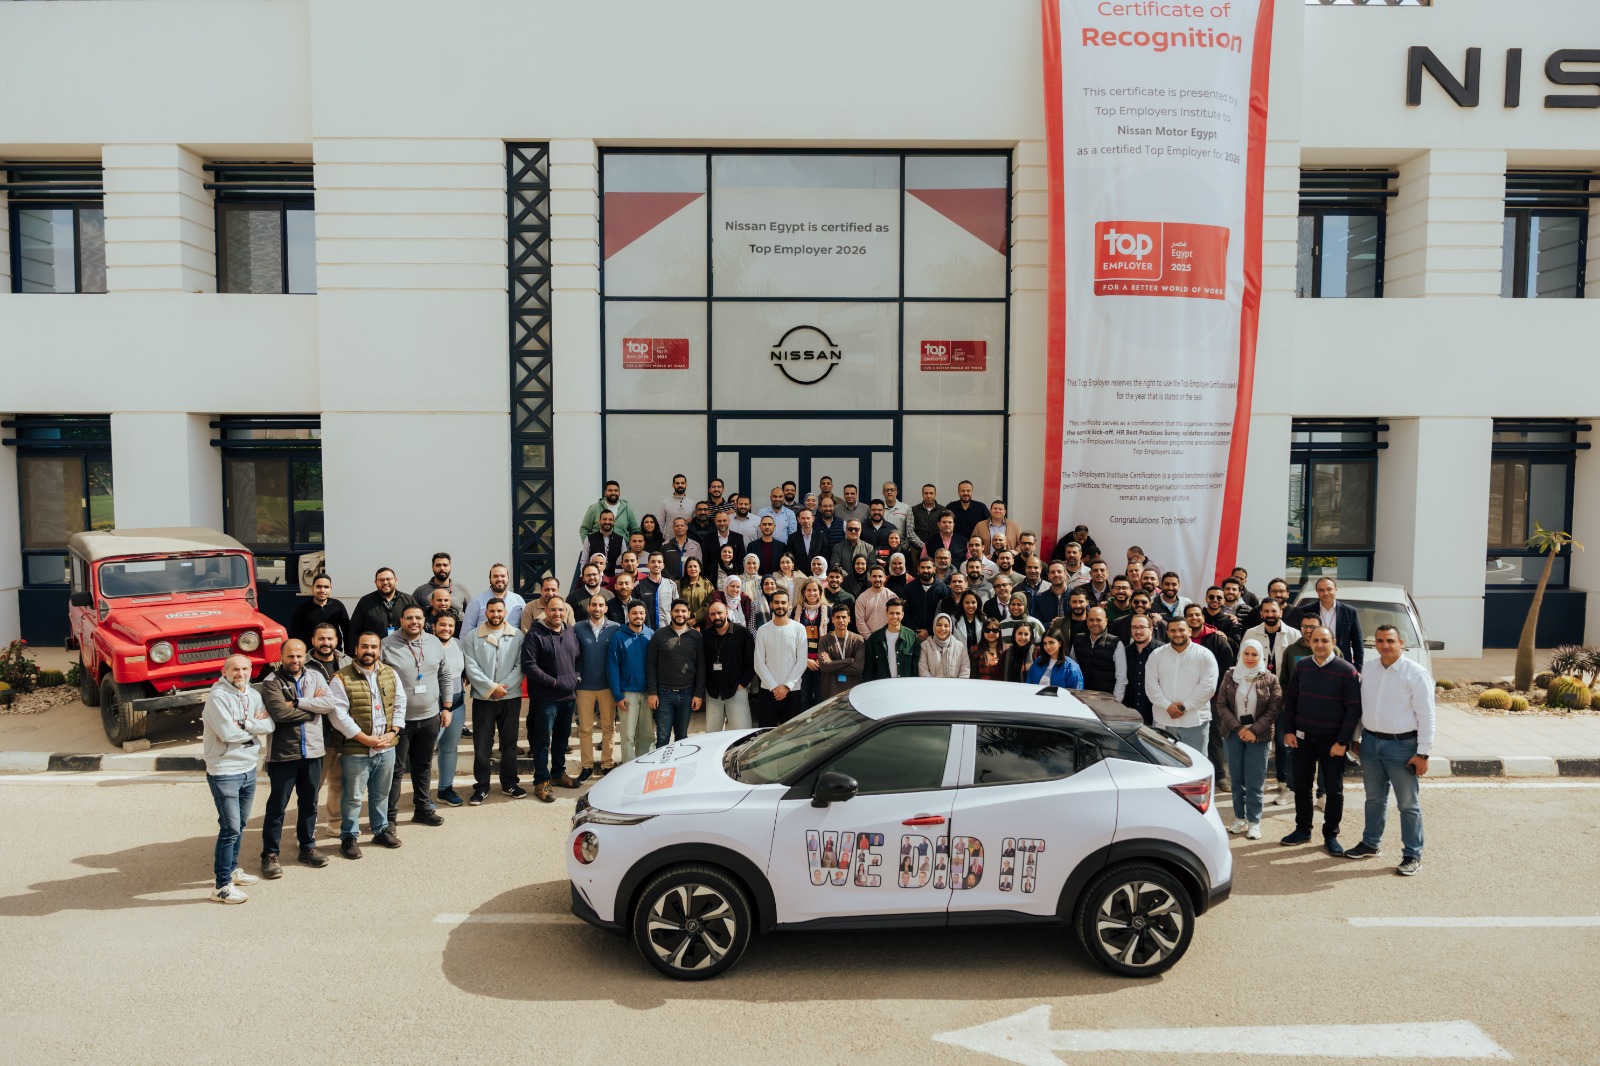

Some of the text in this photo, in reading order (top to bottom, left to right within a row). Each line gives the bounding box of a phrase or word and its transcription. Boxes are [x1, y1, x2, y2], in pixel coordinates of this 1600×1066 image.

[1098, 2, 1230, 18] Certificate of
[1082, 28, 1242, 53] Recognition
[1406, 46, 1600, 108] NIS
[1082, 86, 1238, 106] This certificate is presented by
[1095, 106, 1230, 122] Top Employers Institute to
[1118, 126, 1218, 140] Nissan Motor Egypt
[1077, 148, 1088, 156] as
[1100, 144, 1142, 154] certified
[1144, 146, 1164, 156] Top
[1167, 146, 1210, 158] Employer
[1213, 149, 1224, 158] for
[1224, 152, 1240, 164] 2026
[725, 221, 890, 234] Nissan Egypt is certified as
[749, 244, 866, 256] Top Employer 2026
[1104, 228, 1153, 260] top
[1171, 249, 1194, 260] Egypt
[1103, 262, 1153, 270] EMPLOYER
[1171, 264, 1192, 272] 2025
[626, 341, 648, 354] top
[924, 344, 946, 356] top
[770, 350, 841, 360] NISSAN
[1078, 379, 1087, 388] Top
[1143, 379, 1155, 388] right
[1079, 471, 1105, 479] Employers
[1110, 516, 1159, 525] Congratulations
[1161, 516, 1172, 526] Top
[806, 830, 1046, 894] WE DID IT
